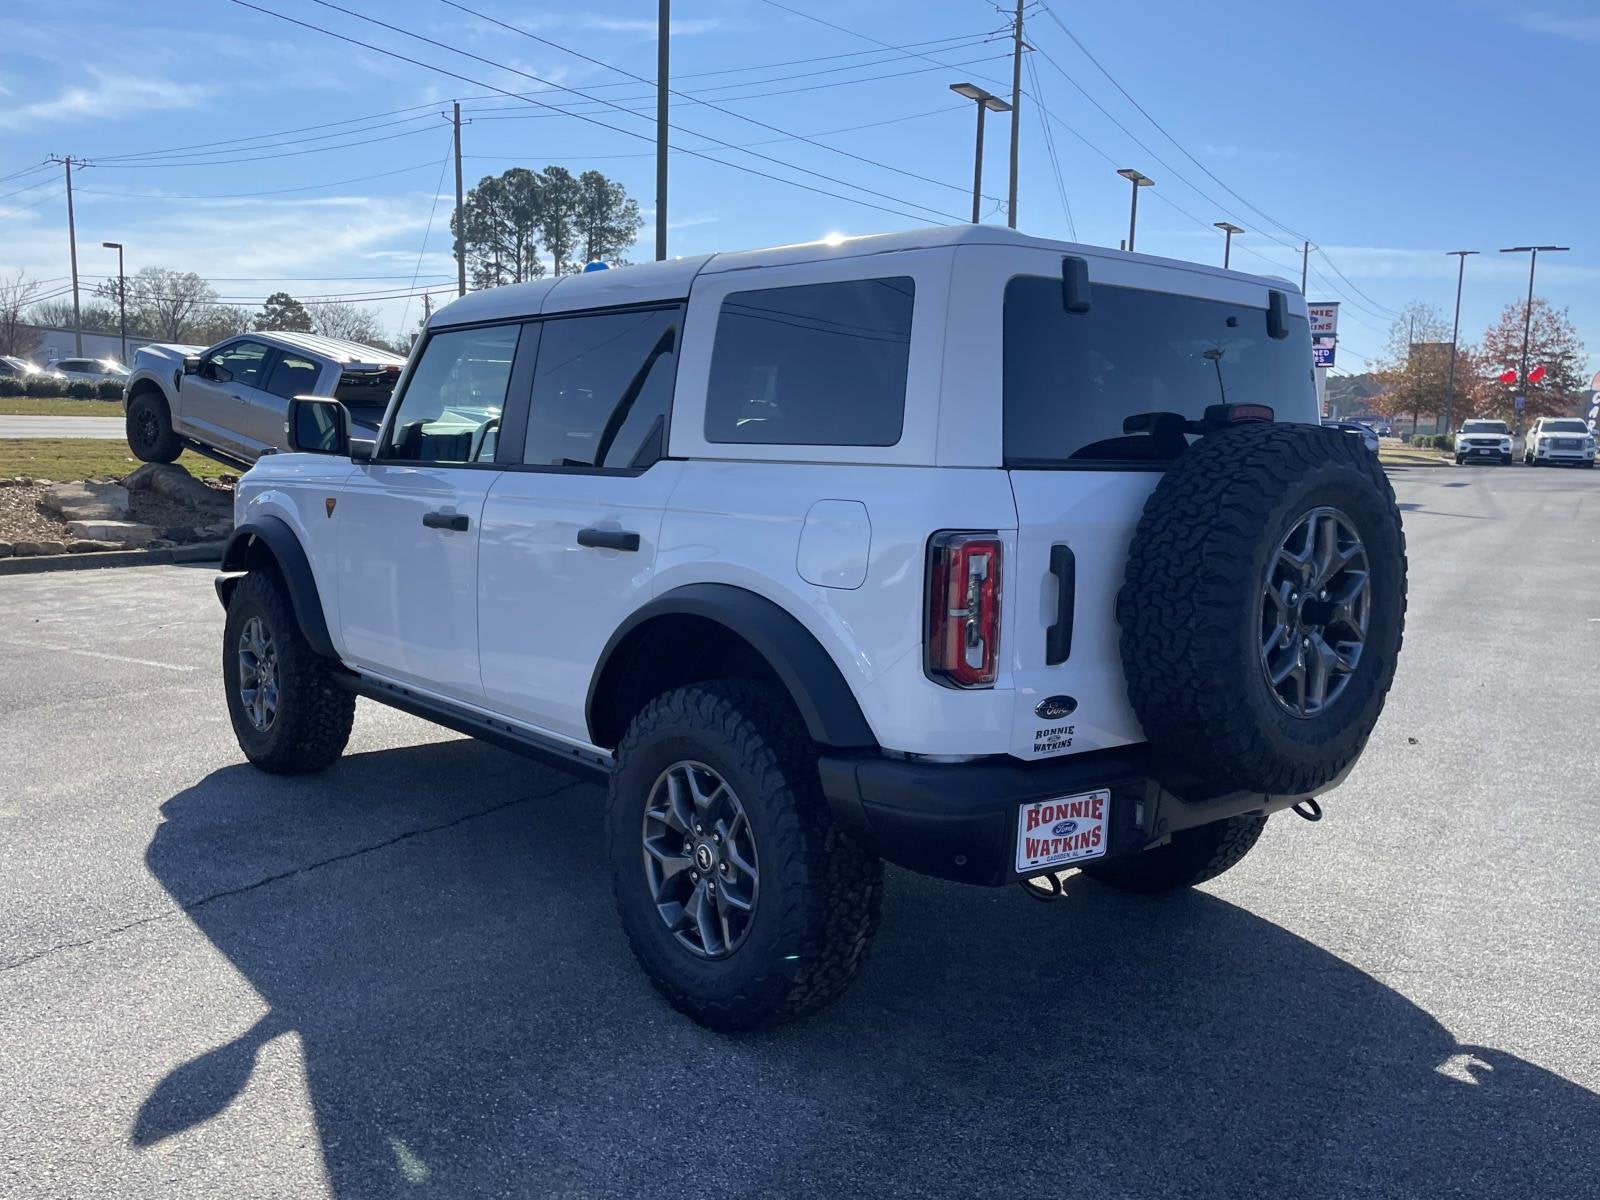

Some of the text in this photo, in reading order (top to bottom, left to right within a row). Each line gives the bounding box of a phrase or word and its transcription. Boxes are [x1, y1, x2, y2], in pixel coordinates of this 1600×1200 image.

[1035, 726, 1075, 739] RONNIE
[1033, 738, 1073, 752] WATKINS
[1027, 799, 1103, 832] RONNIE
[1054, 821, 1076, 835] Ford
[1025, 825, 1102, 859] WATKINS
